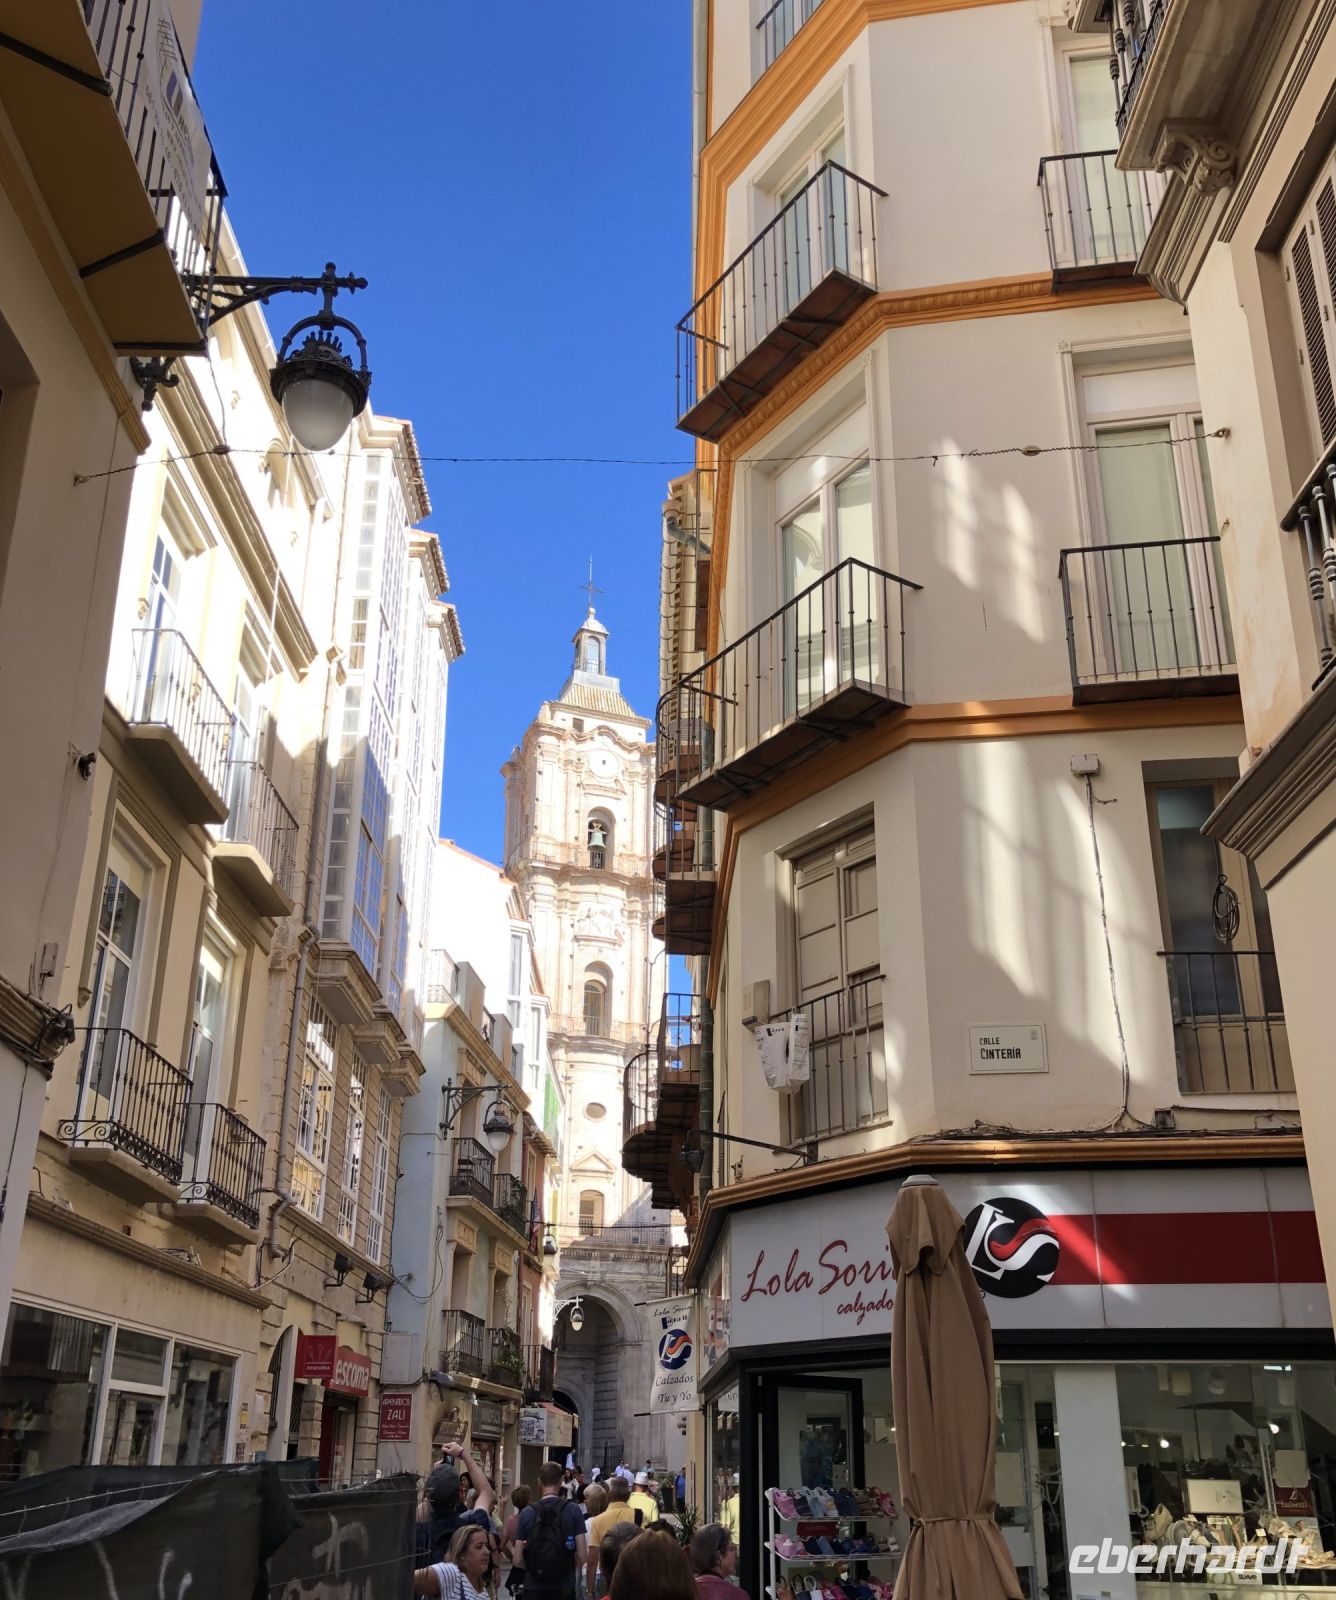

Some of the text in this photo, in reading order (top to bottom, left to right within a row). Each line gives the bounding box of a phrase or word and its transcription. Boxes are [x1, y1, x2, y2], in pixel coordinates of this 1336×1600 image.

[979, 1037, 1000, 1045] CALLE
[980, 1046, 1021, 1060] CINTERÍA
[740, 1249, 813, 1302] Lola
[331, 1359, 369, 1391] escoma
[656, 1373, 694, 1387] Calzados
[671, 1394, 678, 1406] y
[679, 1390, 692, 1401] Yo
[387, 1409, 406, 1420] ZALI
